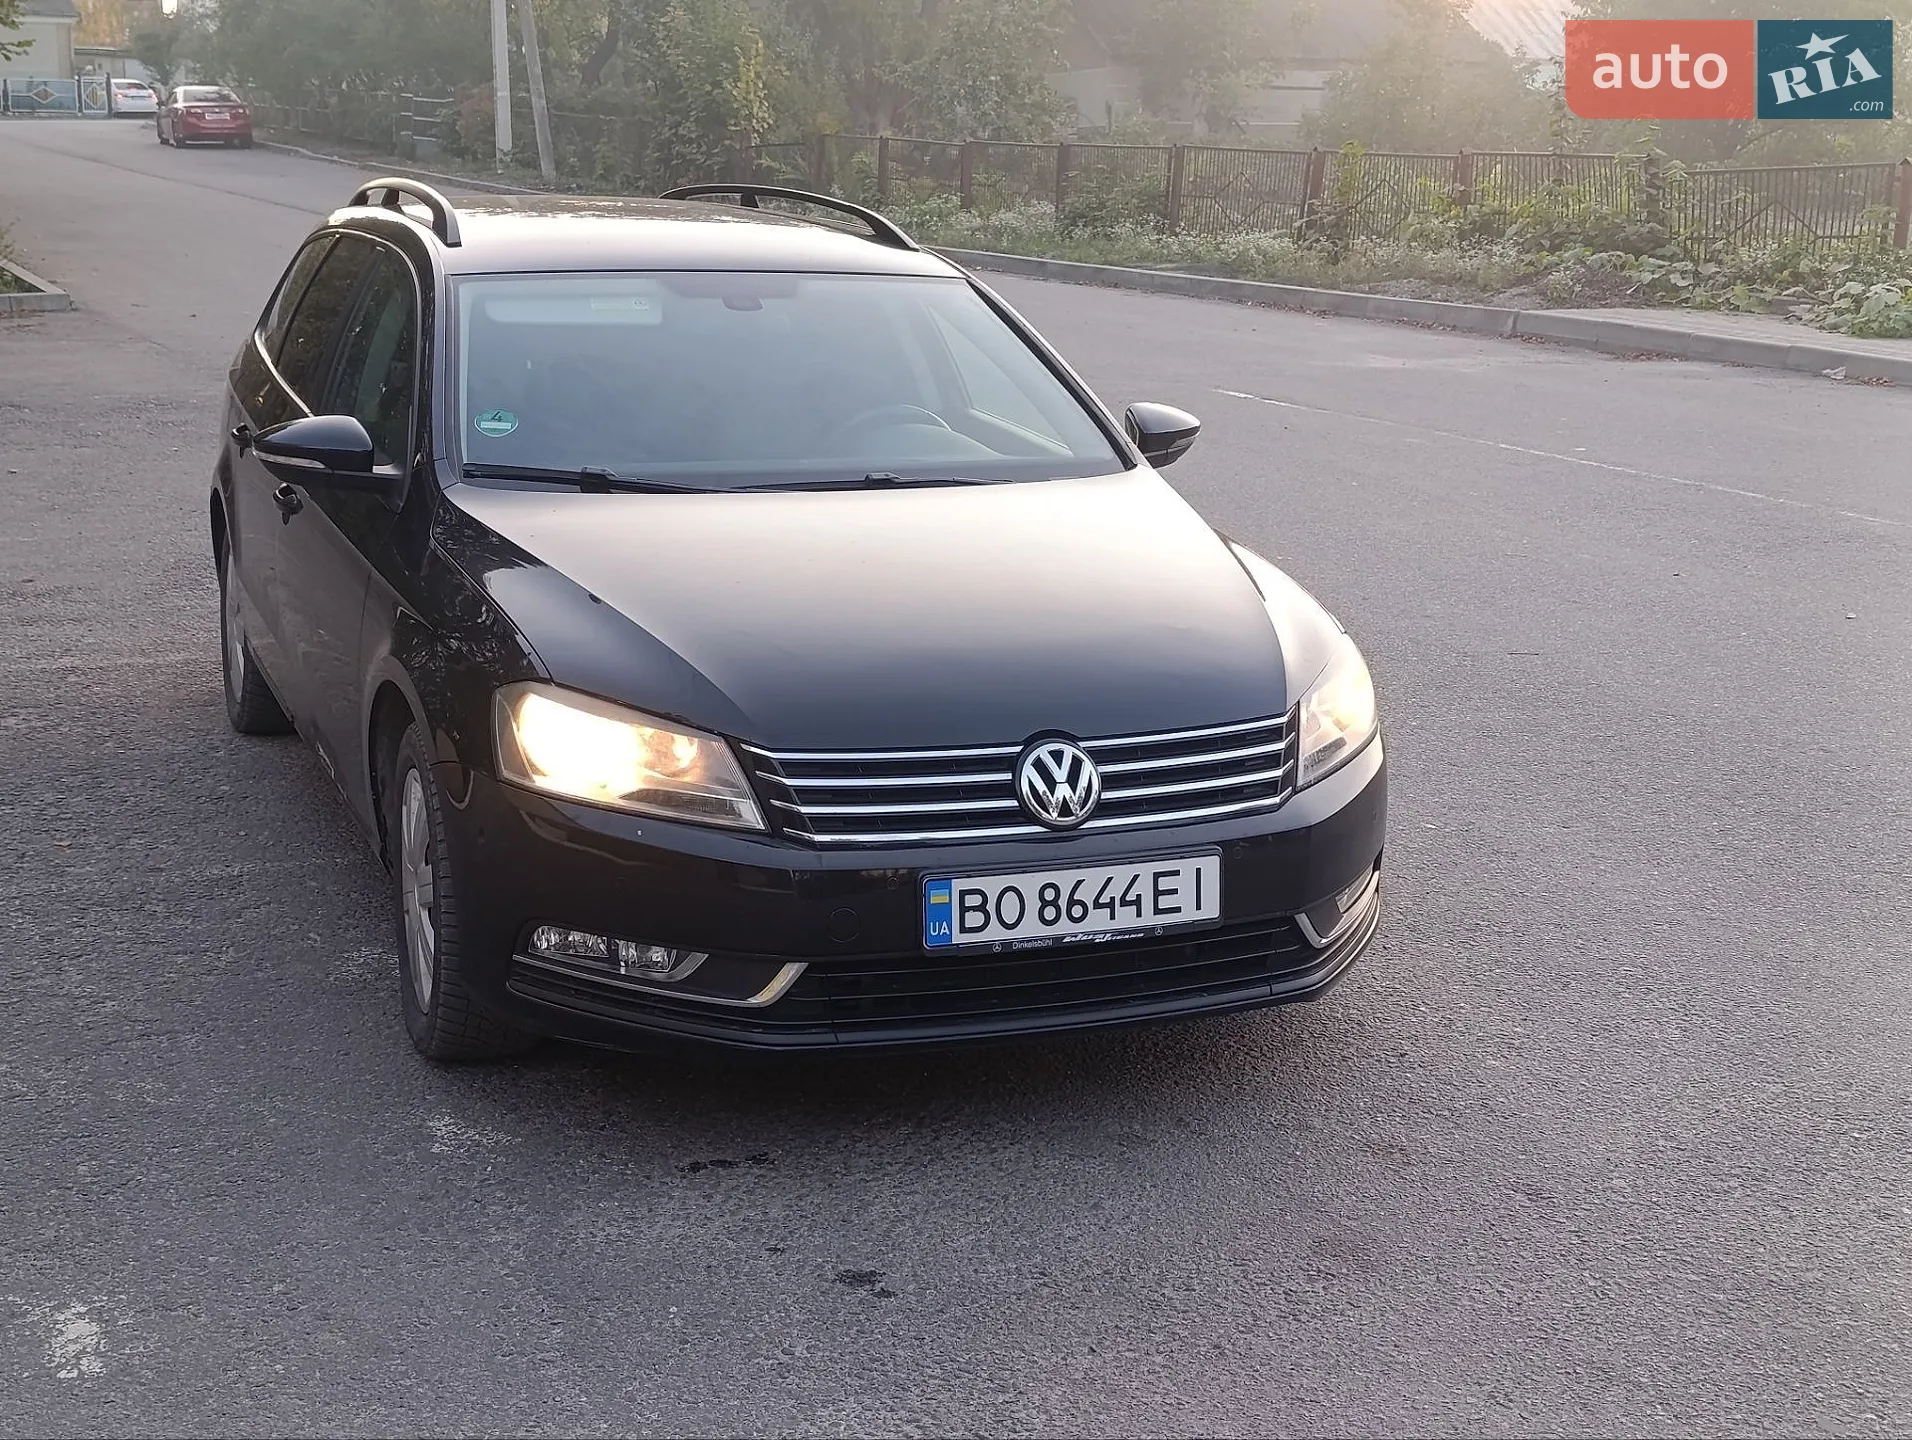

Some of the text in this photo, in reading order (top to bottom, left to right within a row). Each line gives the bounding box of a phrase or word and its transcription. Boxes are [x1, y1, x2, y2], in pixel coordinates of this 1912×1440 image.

[491, 411, 503, 422] 4
[959, 885, 1026, 934] BO
[1038, 873, 1143, 926] 8644
[930, 921, 950, 936] UA
